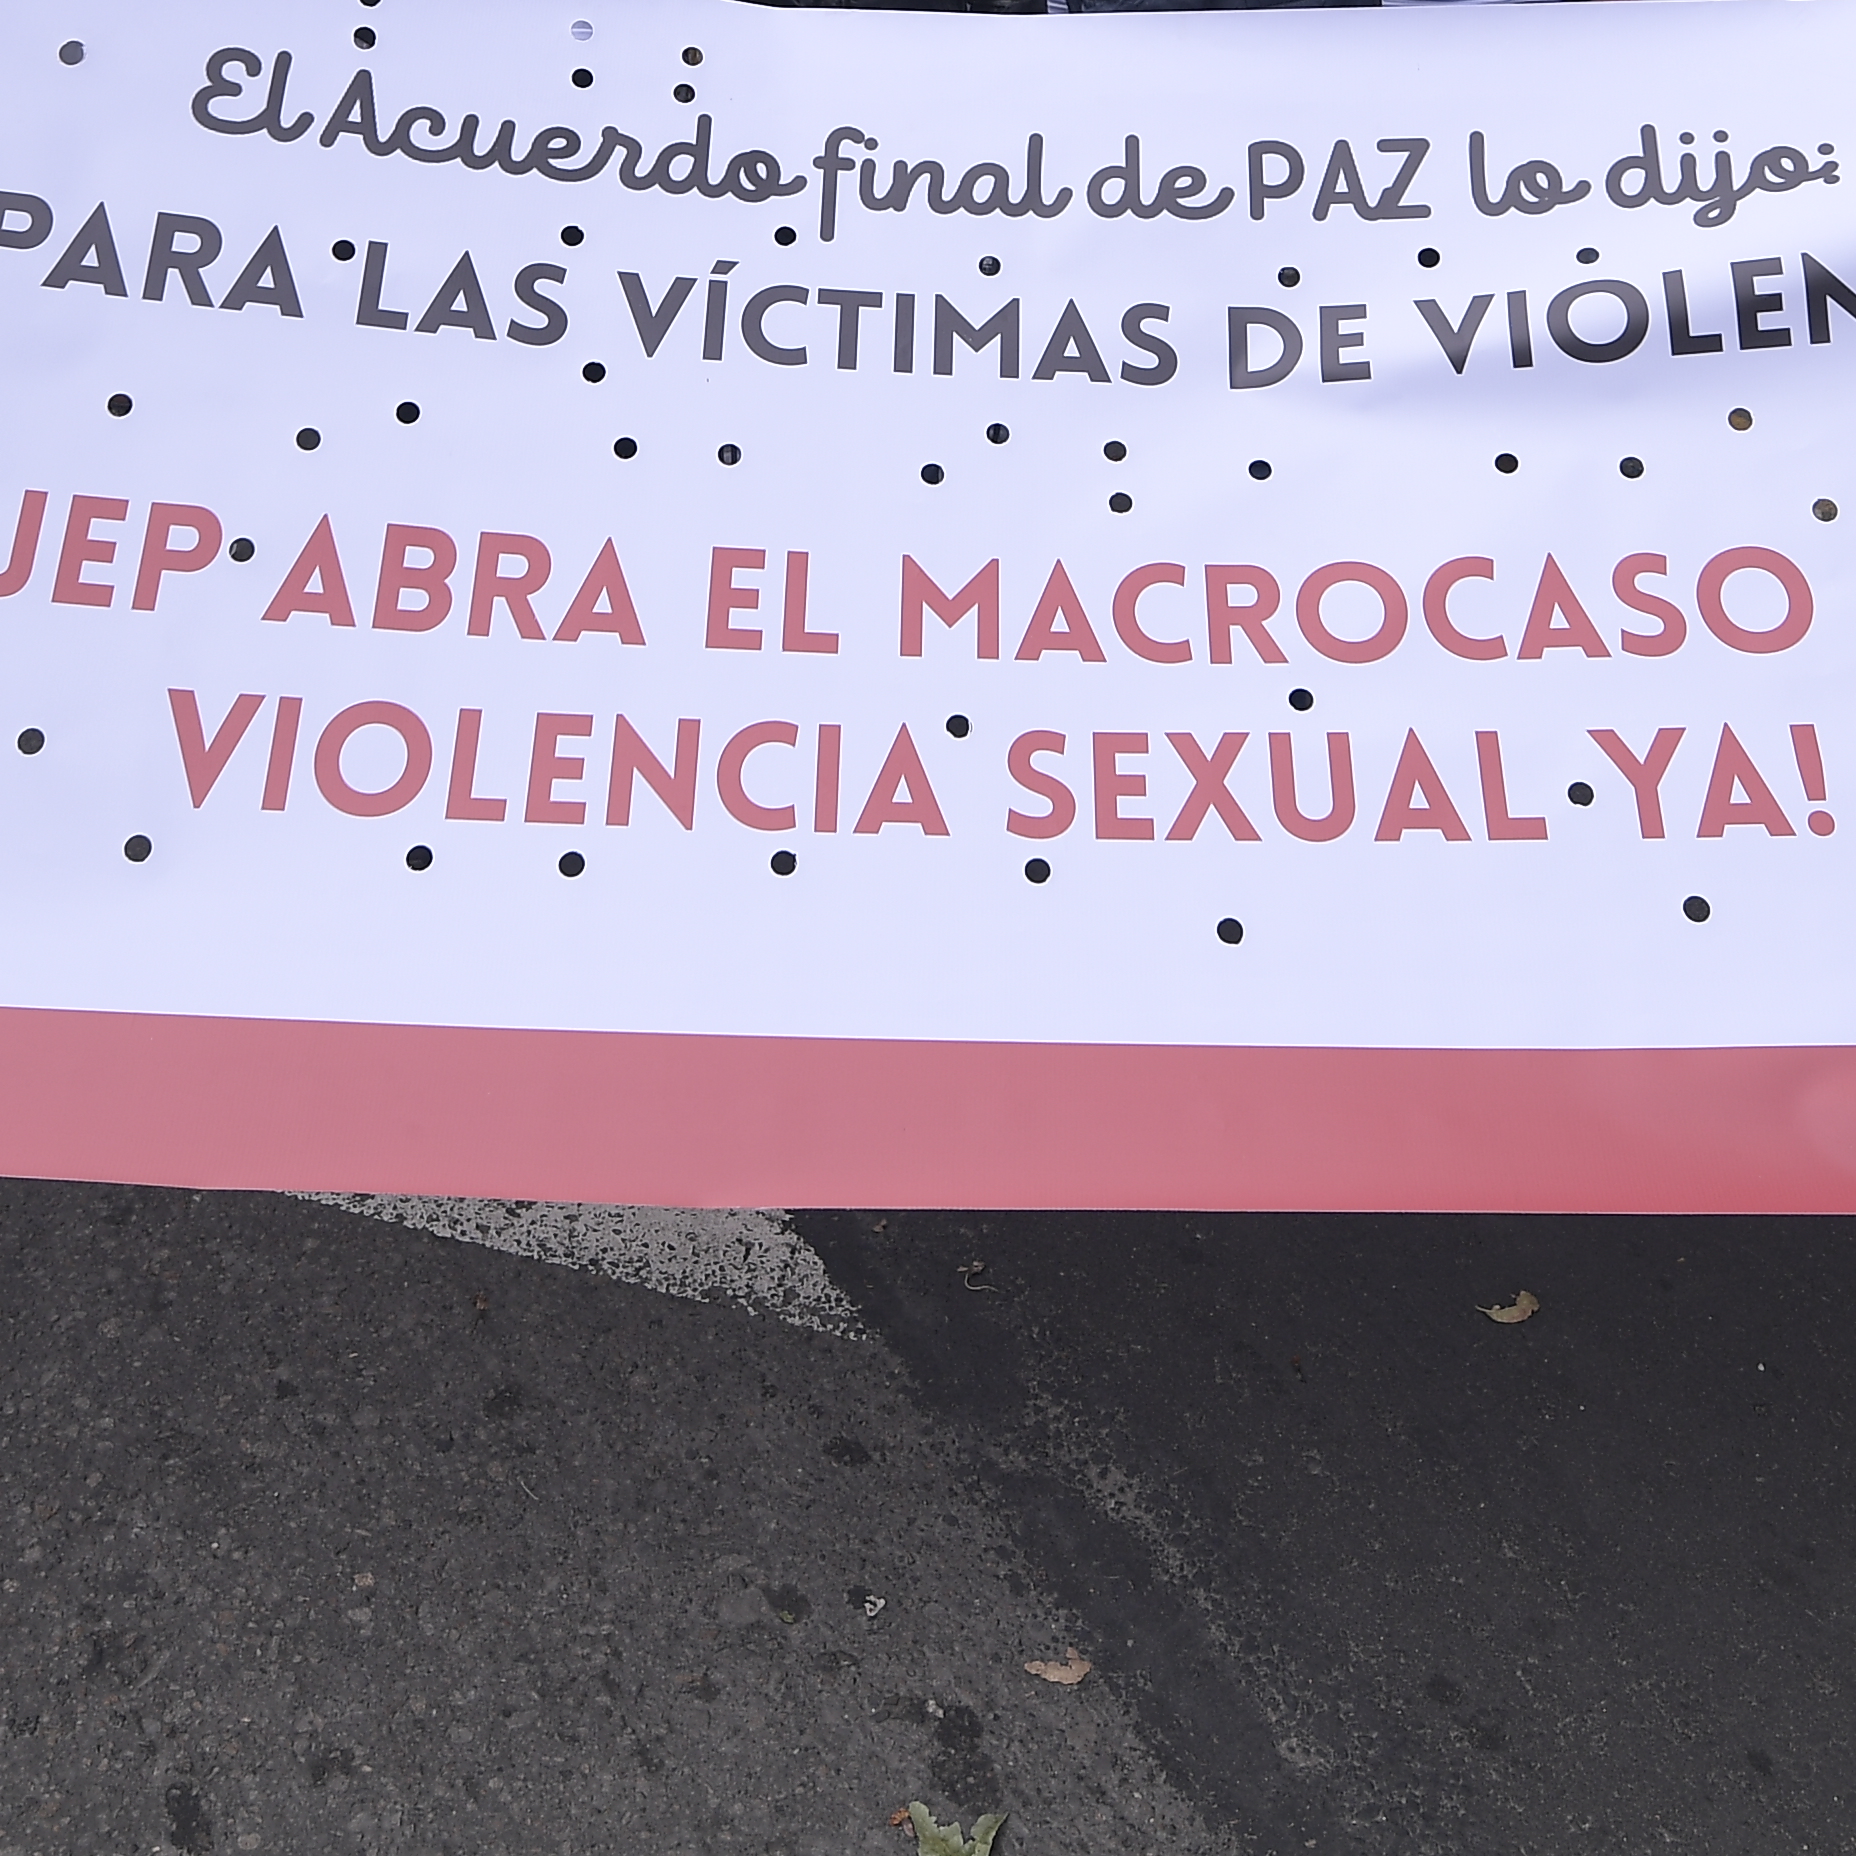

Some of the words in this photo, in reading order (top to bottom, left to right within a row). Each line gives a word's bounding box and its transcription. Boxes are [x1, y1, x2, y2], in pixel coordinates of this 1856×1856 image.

[191, 44, 316, 142] El
[318, 66, 806, 202] Acuerdo
[814, 125, 1072, 241] final
[1086, 133, 1235, 221] de
[1249, 136, 1432, 221] PAZ
[1468, 130, 1591, 217] lo
[1605, 123, 1842, 228] dijo:
[354, 240, 570, 345] LAS
[616, 259, 1181, 388] VÍCTIMAS
[1229, 302, 1373, 390] DE
[260, 512, 647, 647] ABRA
[704, 546, 840, 655] EL
[899, 545, 1815, 665] MACROCASO
[166, 686, 952, 838] VIOLENCIA
[1006, 726, 1548, 843] SEXUAL
[1585, 721, 1836, 839] YA!
